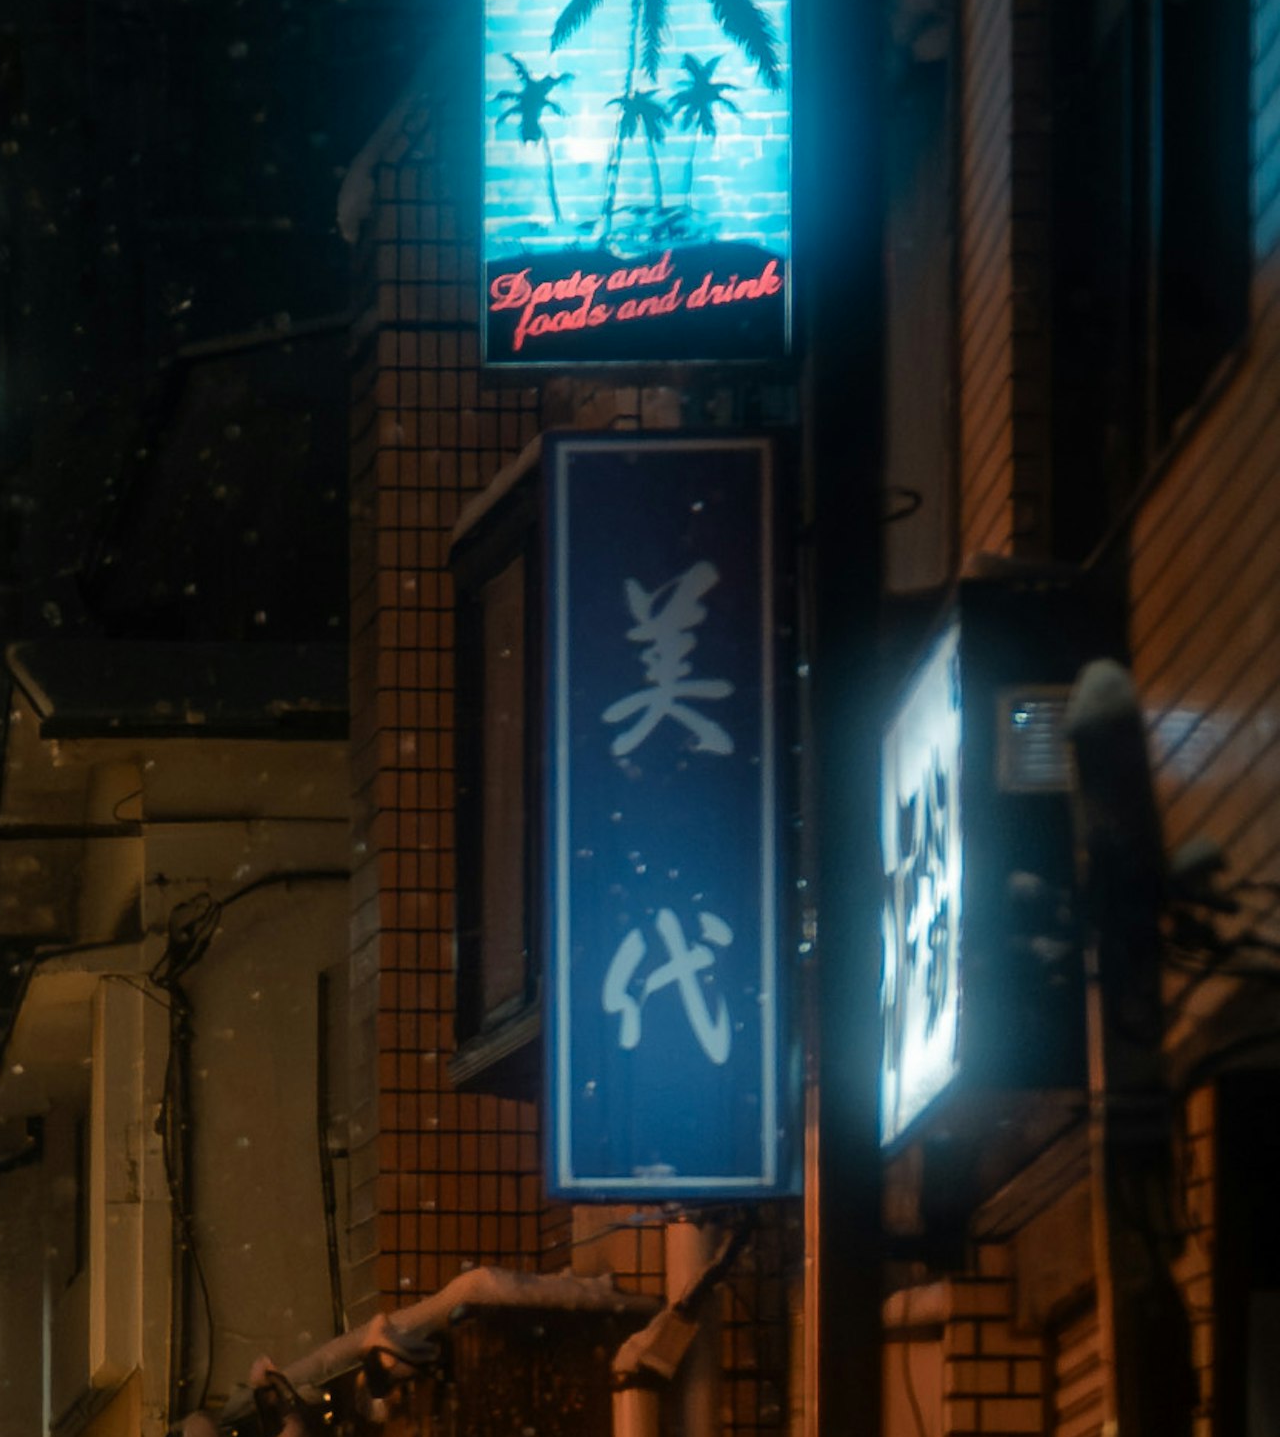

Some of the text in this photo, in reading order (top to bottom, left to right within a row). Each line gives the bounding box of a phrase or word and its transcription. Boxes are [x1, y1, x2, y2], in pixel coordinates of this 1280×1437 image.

[490, 249, 676, 312] Darts and
[512, 259, 782, 351] foods and drink
[601, 559, 735, 1066] 美代
